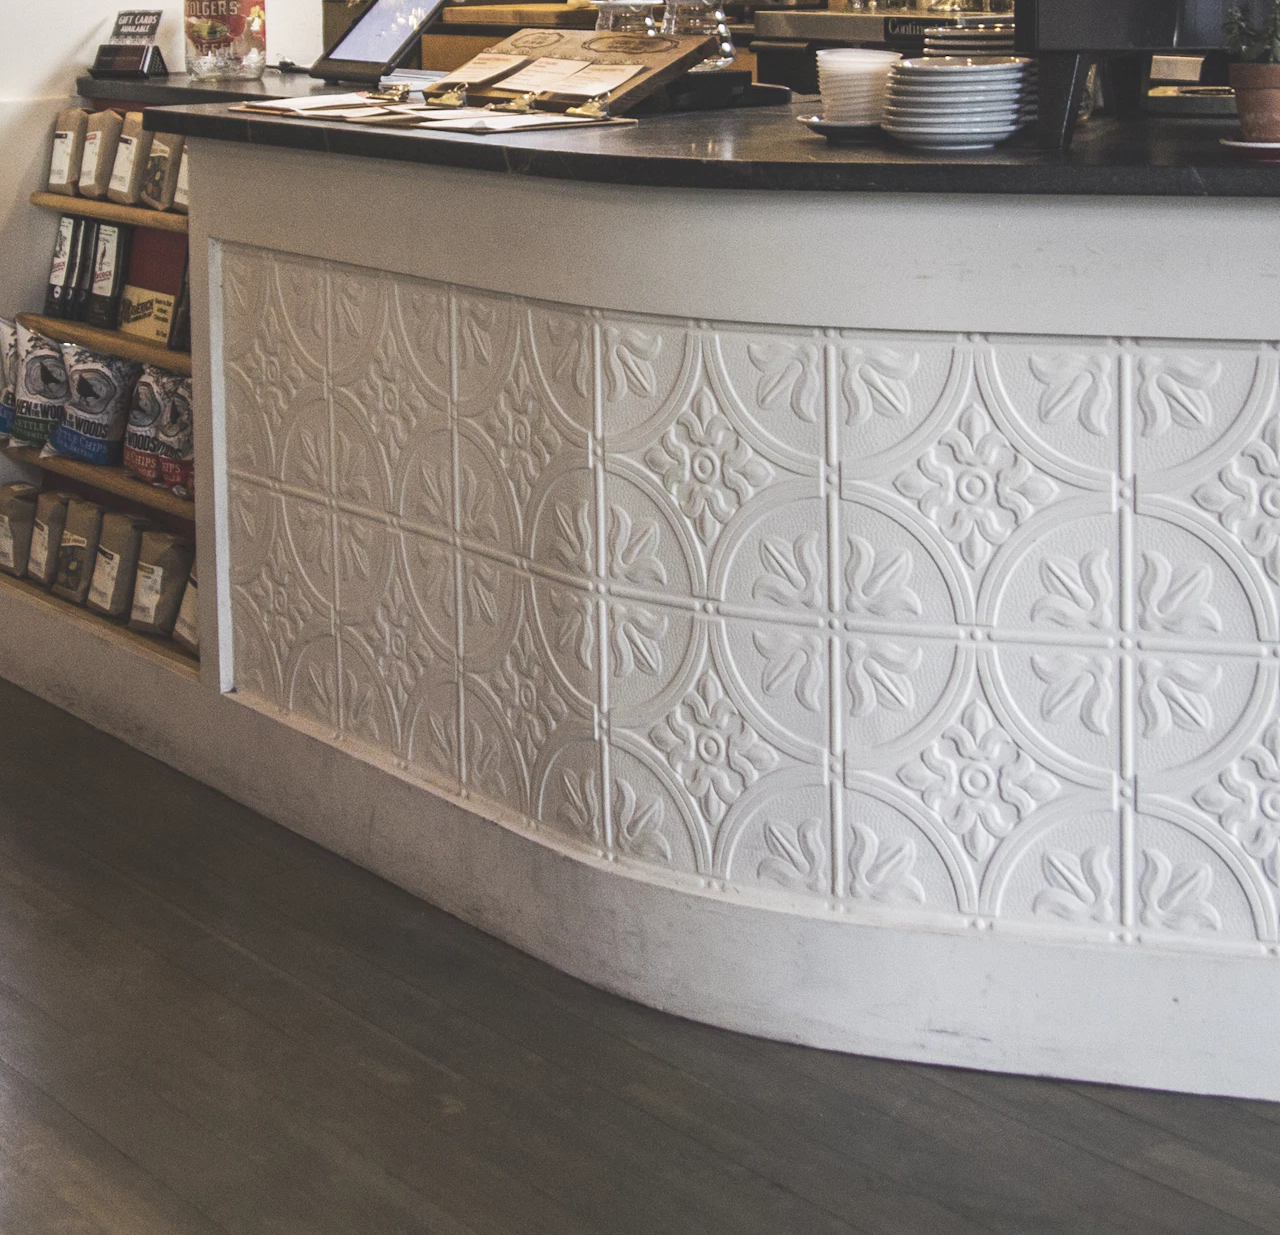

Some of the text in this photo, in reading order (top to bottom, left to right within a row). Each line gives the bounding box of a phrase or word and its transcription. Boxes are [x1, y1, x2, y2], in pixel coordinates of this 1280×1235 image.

[118, 15, 157, 25] GIFT CARDS
[120, 24, 149, 33] AVAILABLE
[75, 416, 109, 439] WOODS
[127, 432, 159, 454] WOODS
